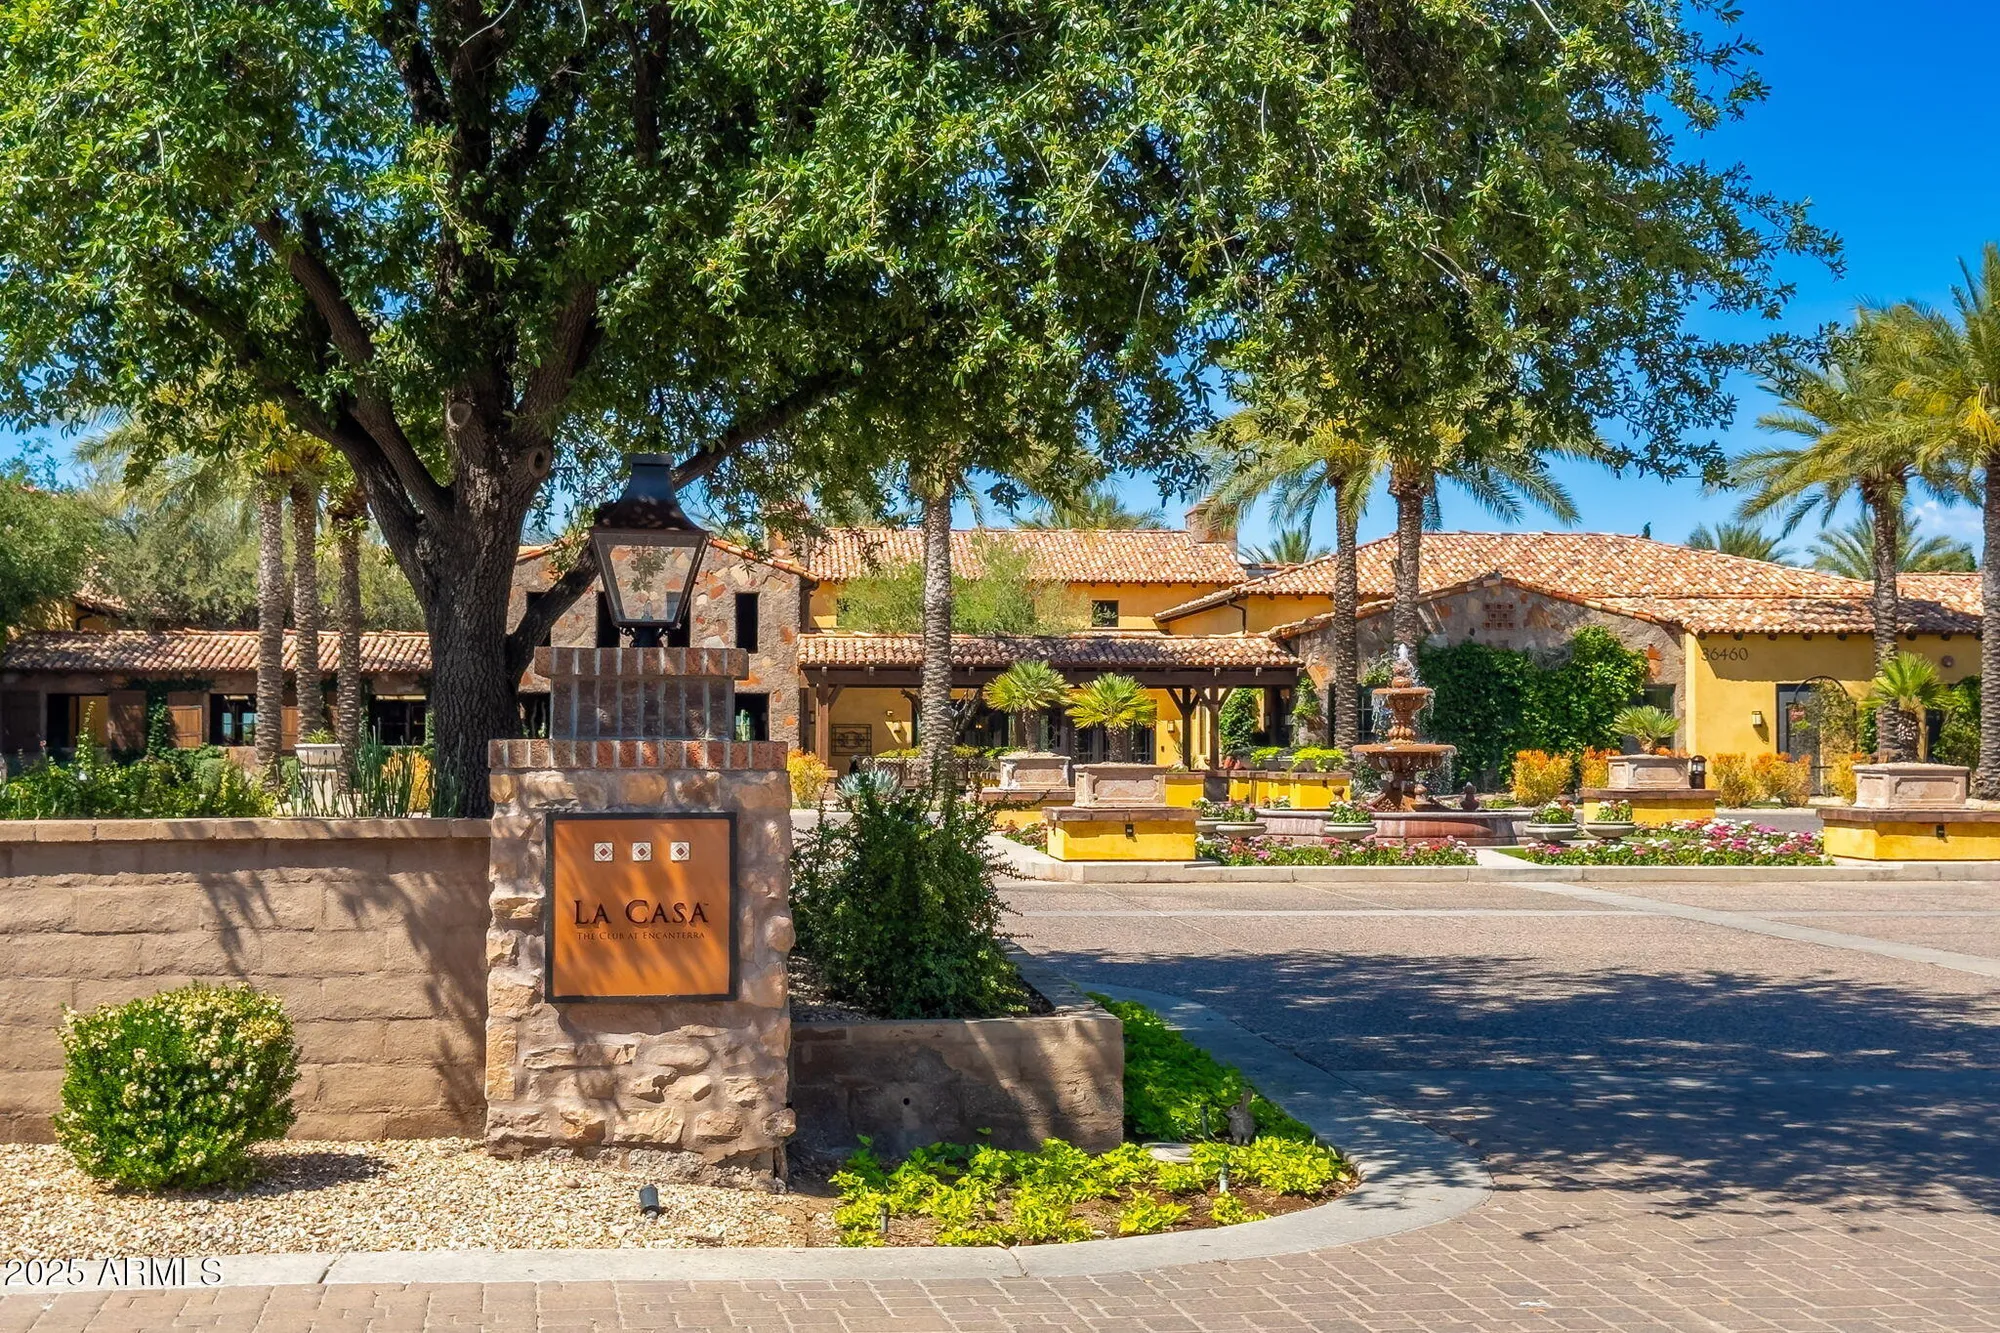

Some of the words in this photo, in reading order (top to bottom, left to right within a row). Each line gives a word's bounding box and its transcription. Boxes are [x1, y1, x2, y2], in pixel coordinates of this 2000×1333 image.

[1701, 647, 1748, 661] 36460
[574, 900, 611, 924] LA
[578, 932, 595, 940] THE
[599, 931, 625, 940] CLUB
[628, 932, 639, 940] AT
[642, 931, 705, 940] ENCANTERRA
